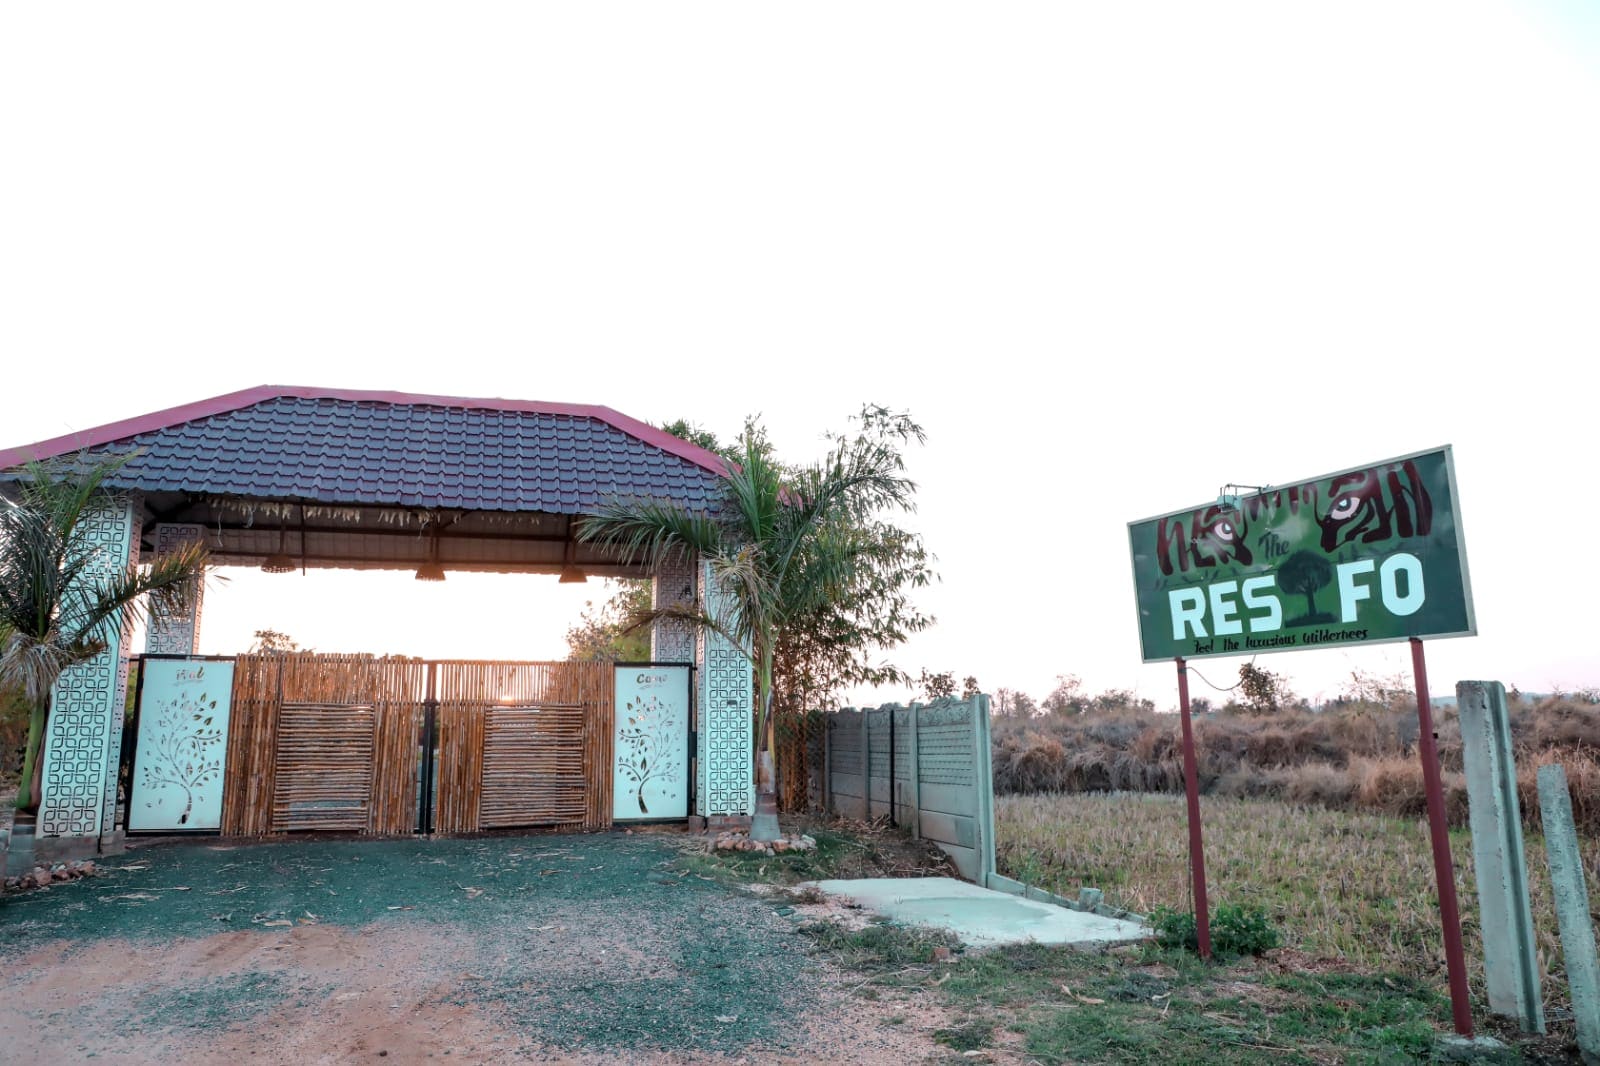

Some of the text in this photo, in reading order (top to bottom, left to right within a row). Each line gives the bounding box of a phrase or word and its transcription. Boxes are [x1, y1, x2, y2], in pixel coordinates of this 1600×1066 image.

[1258, 531, 1290, 561] The
[1168, 552, 1426, 640] RES FO
